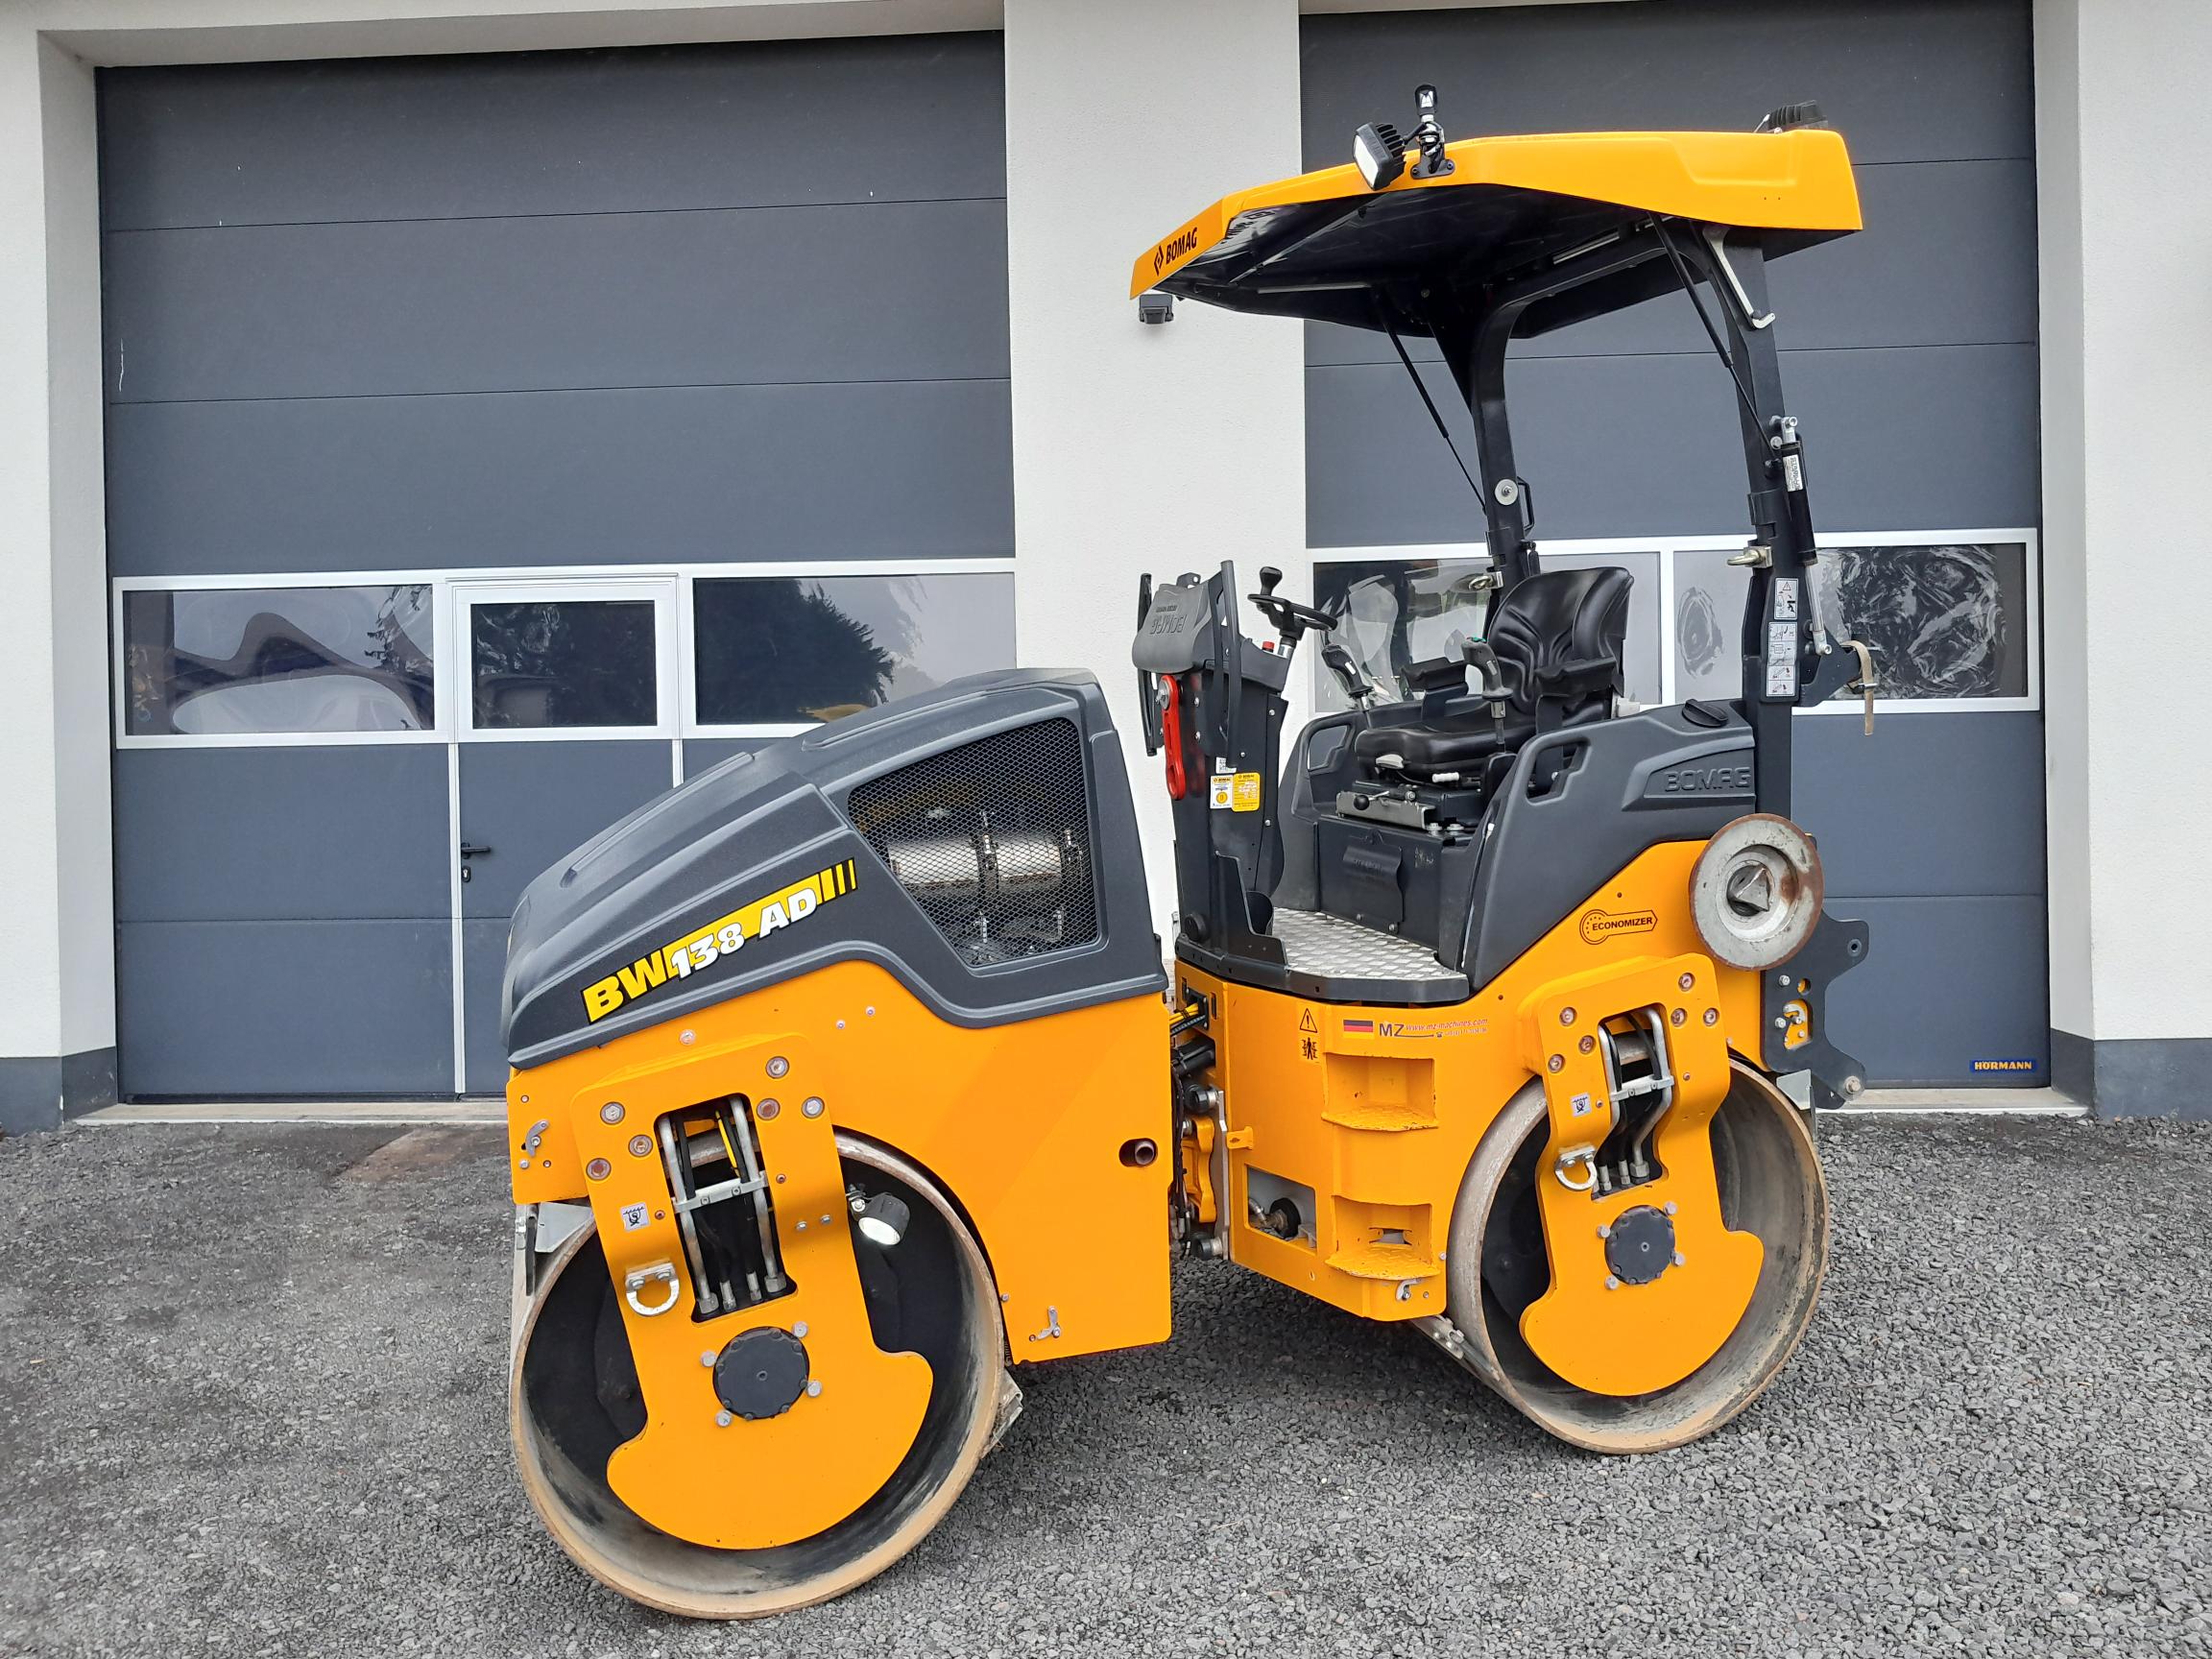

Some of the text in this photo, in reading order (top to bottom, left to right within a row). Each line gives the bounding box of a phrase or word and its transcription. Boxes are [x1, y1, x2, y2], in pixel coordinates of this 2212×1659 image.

[1166, 227, 1198, 265] BOMAG
[1664, 766, 1751, 793] BOMAG
[1592, 916, 1653, 931] ECONOMIZER
[583, 887, 819, 1022] BW 138 AD
[1379, 1022, 1405, 1037] MZ
